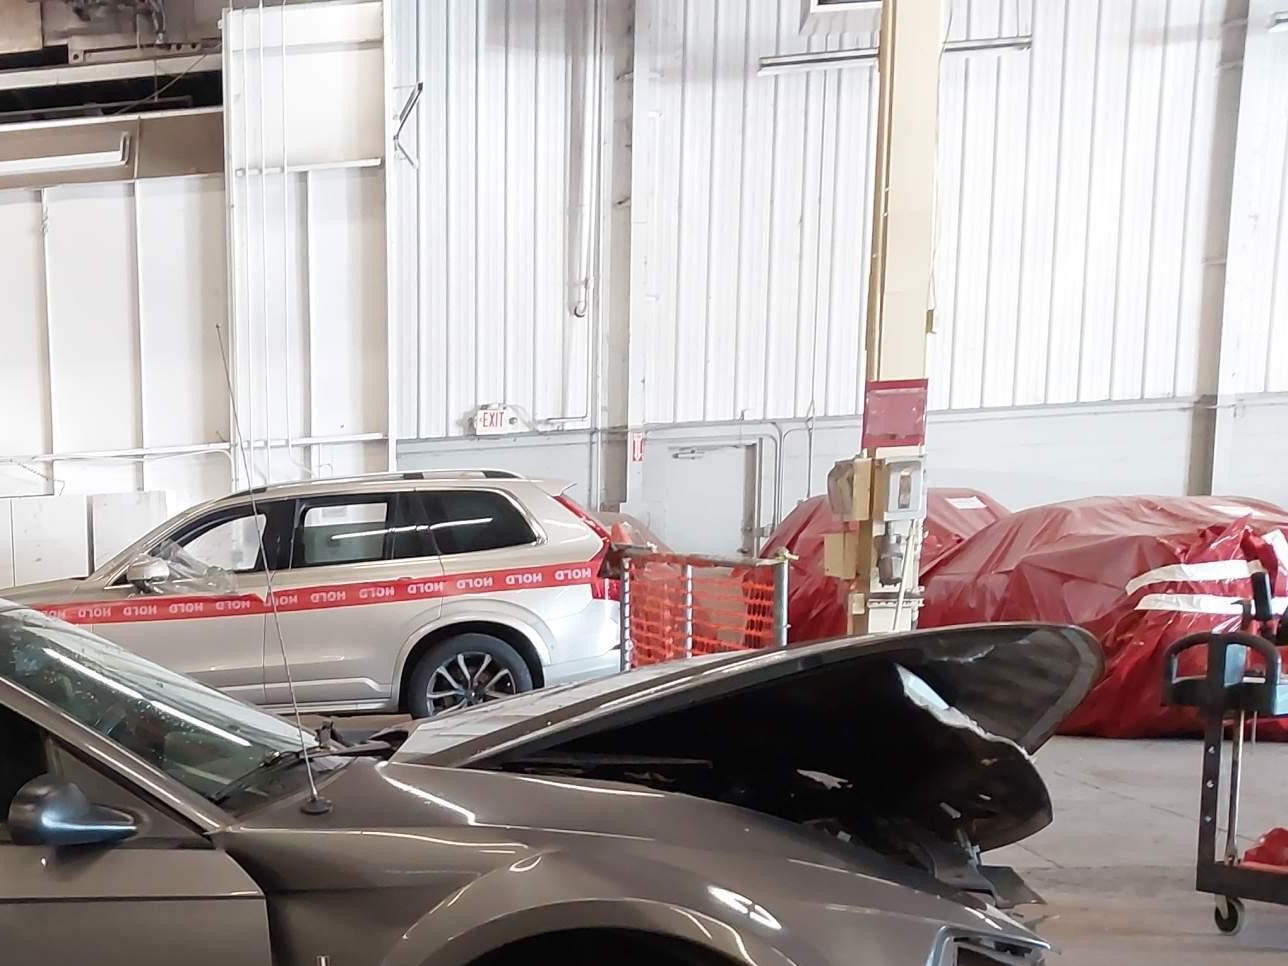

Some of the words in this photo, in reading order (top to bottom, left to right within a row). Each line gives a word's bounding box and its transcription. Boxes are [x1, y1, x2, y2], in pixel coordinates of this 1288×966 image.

[483, 411, 504, 427] EXIT
[78, 607, 111, 618] HOLD
[123, 605, 157, 616] HOLD
[169, 602, 204, 614] HOLD
[215, 600, 250, 611] HOLD
[310, 591, 346, 603] HOLD
[359, 586, 395, 599] HOLD
[407, 581, 444, 594] HOLD
[456, 577, 493, 589] HOLD
[505, 573, 542, 585] HOLD
[555, 568, 592, 580] HOLD
